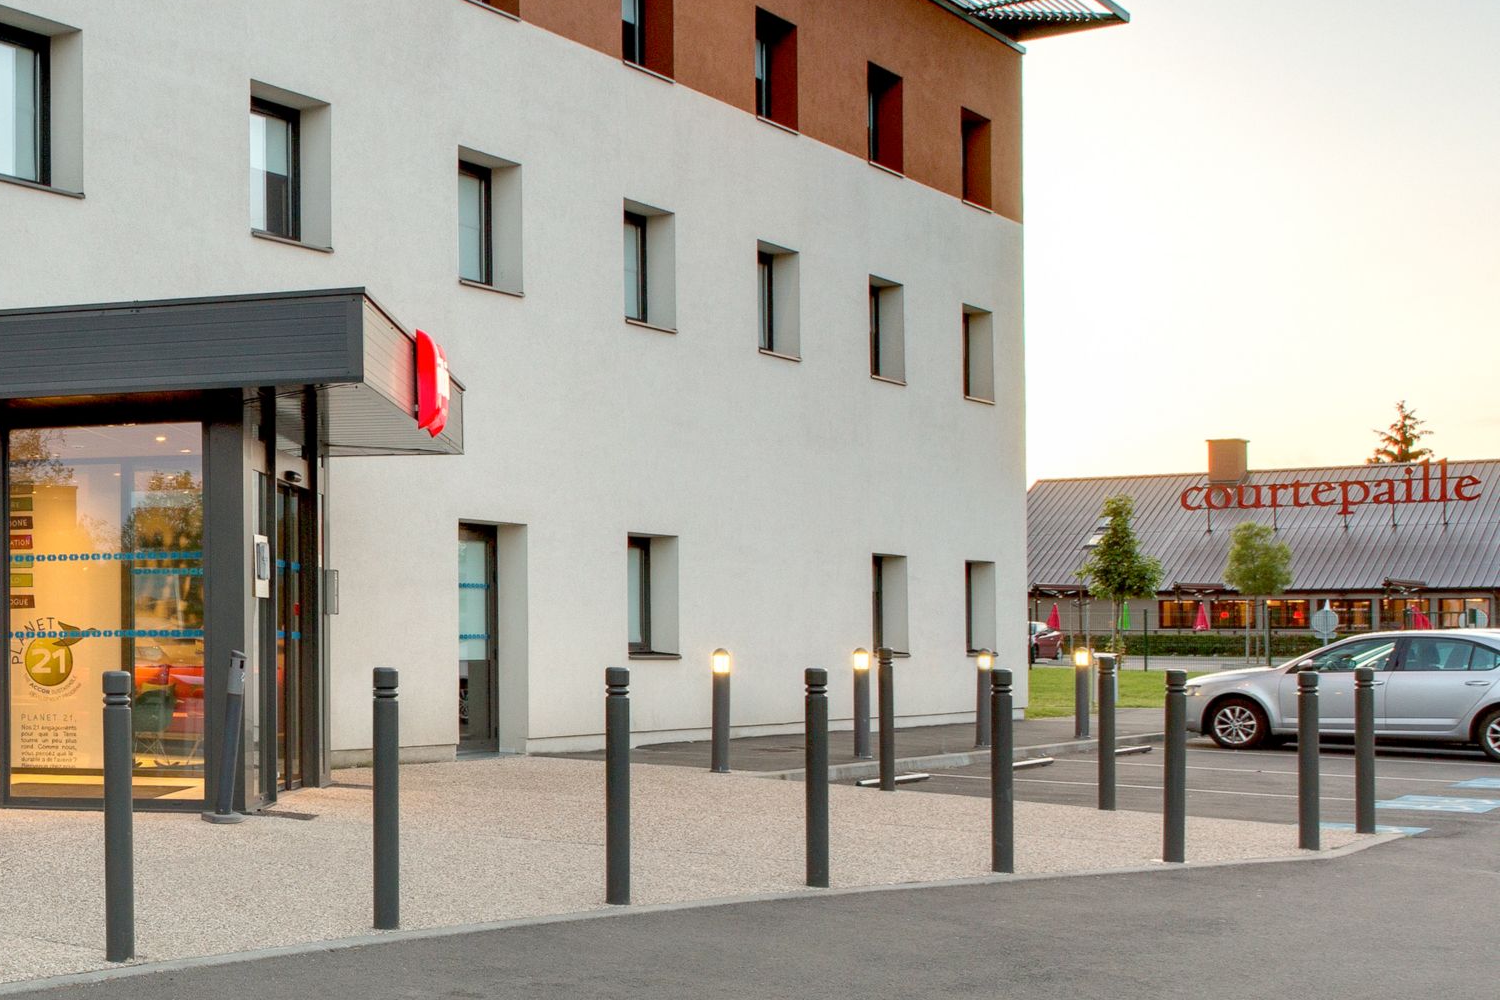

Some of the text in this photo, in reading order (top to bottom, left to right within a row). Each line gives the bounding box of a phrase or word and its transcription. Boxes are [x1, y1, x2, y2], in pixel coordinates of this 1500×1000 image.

[1181, 457, 1482, 516] courtepaille
[31, 648, 66, 674] 21
[20, 713, 58, 722] PLANET
